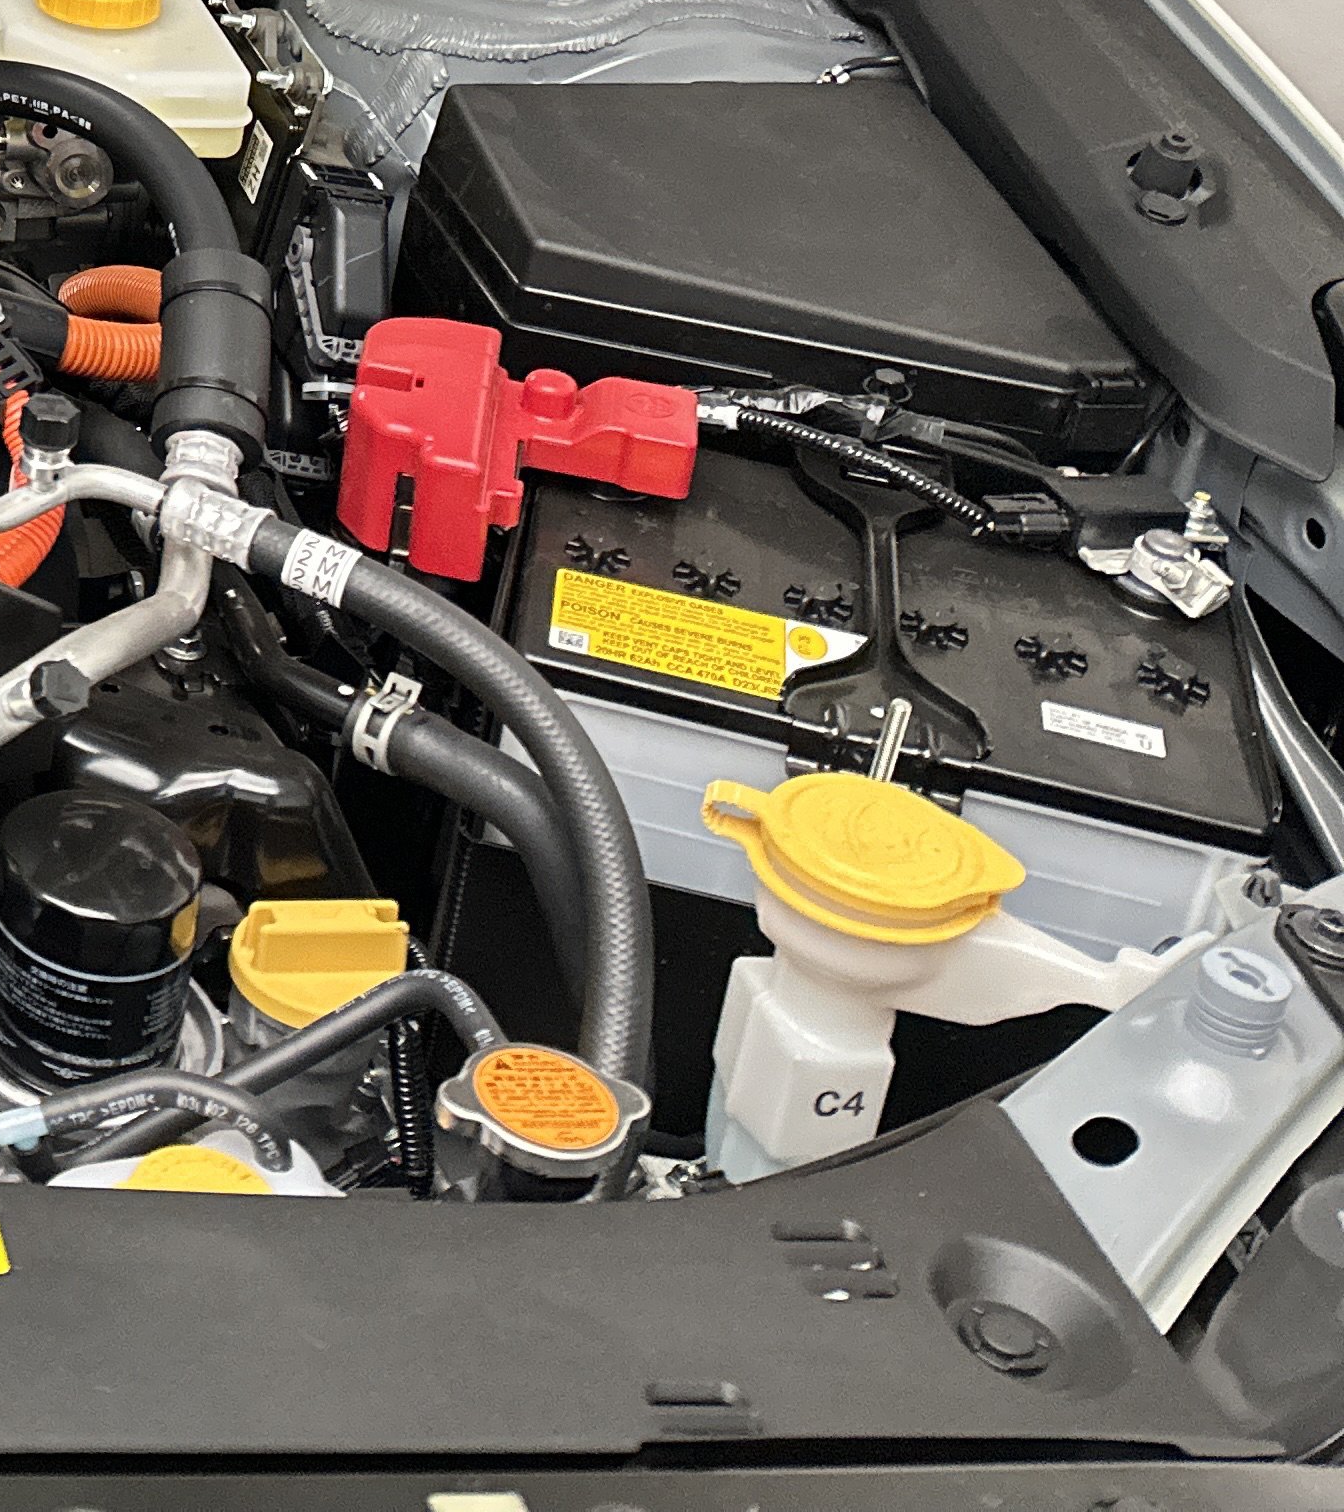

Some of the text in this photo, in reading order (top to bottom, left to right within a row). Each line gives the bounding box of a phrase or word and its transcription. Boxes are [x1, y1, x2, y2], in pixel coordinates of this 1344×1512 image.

[316, 556, 340, 577] M
[312, 575, 332, 595] M
[563, 572, 626, 593] DANGER
[631, 589, 687, 606] EXPLOSIVE
[560, 600, 753, 651] POISON CAUSES SEVERE BURNS
[595, 645, 627, 659] 20HR
[666, 661, 693, 675] CCA
[603, 631, 630, 642] KEEP
[633, 637, 659, 648] VENT
[662, 644, 690, 656] CAPS
[693, 651, 723, 663] TIGHT
[726, 659, 747, 671] AND
[603, 638, 780, 685] KEEP OUT OF REACH OF CHILDREN
[814, 1090, 865, 1117] C4
